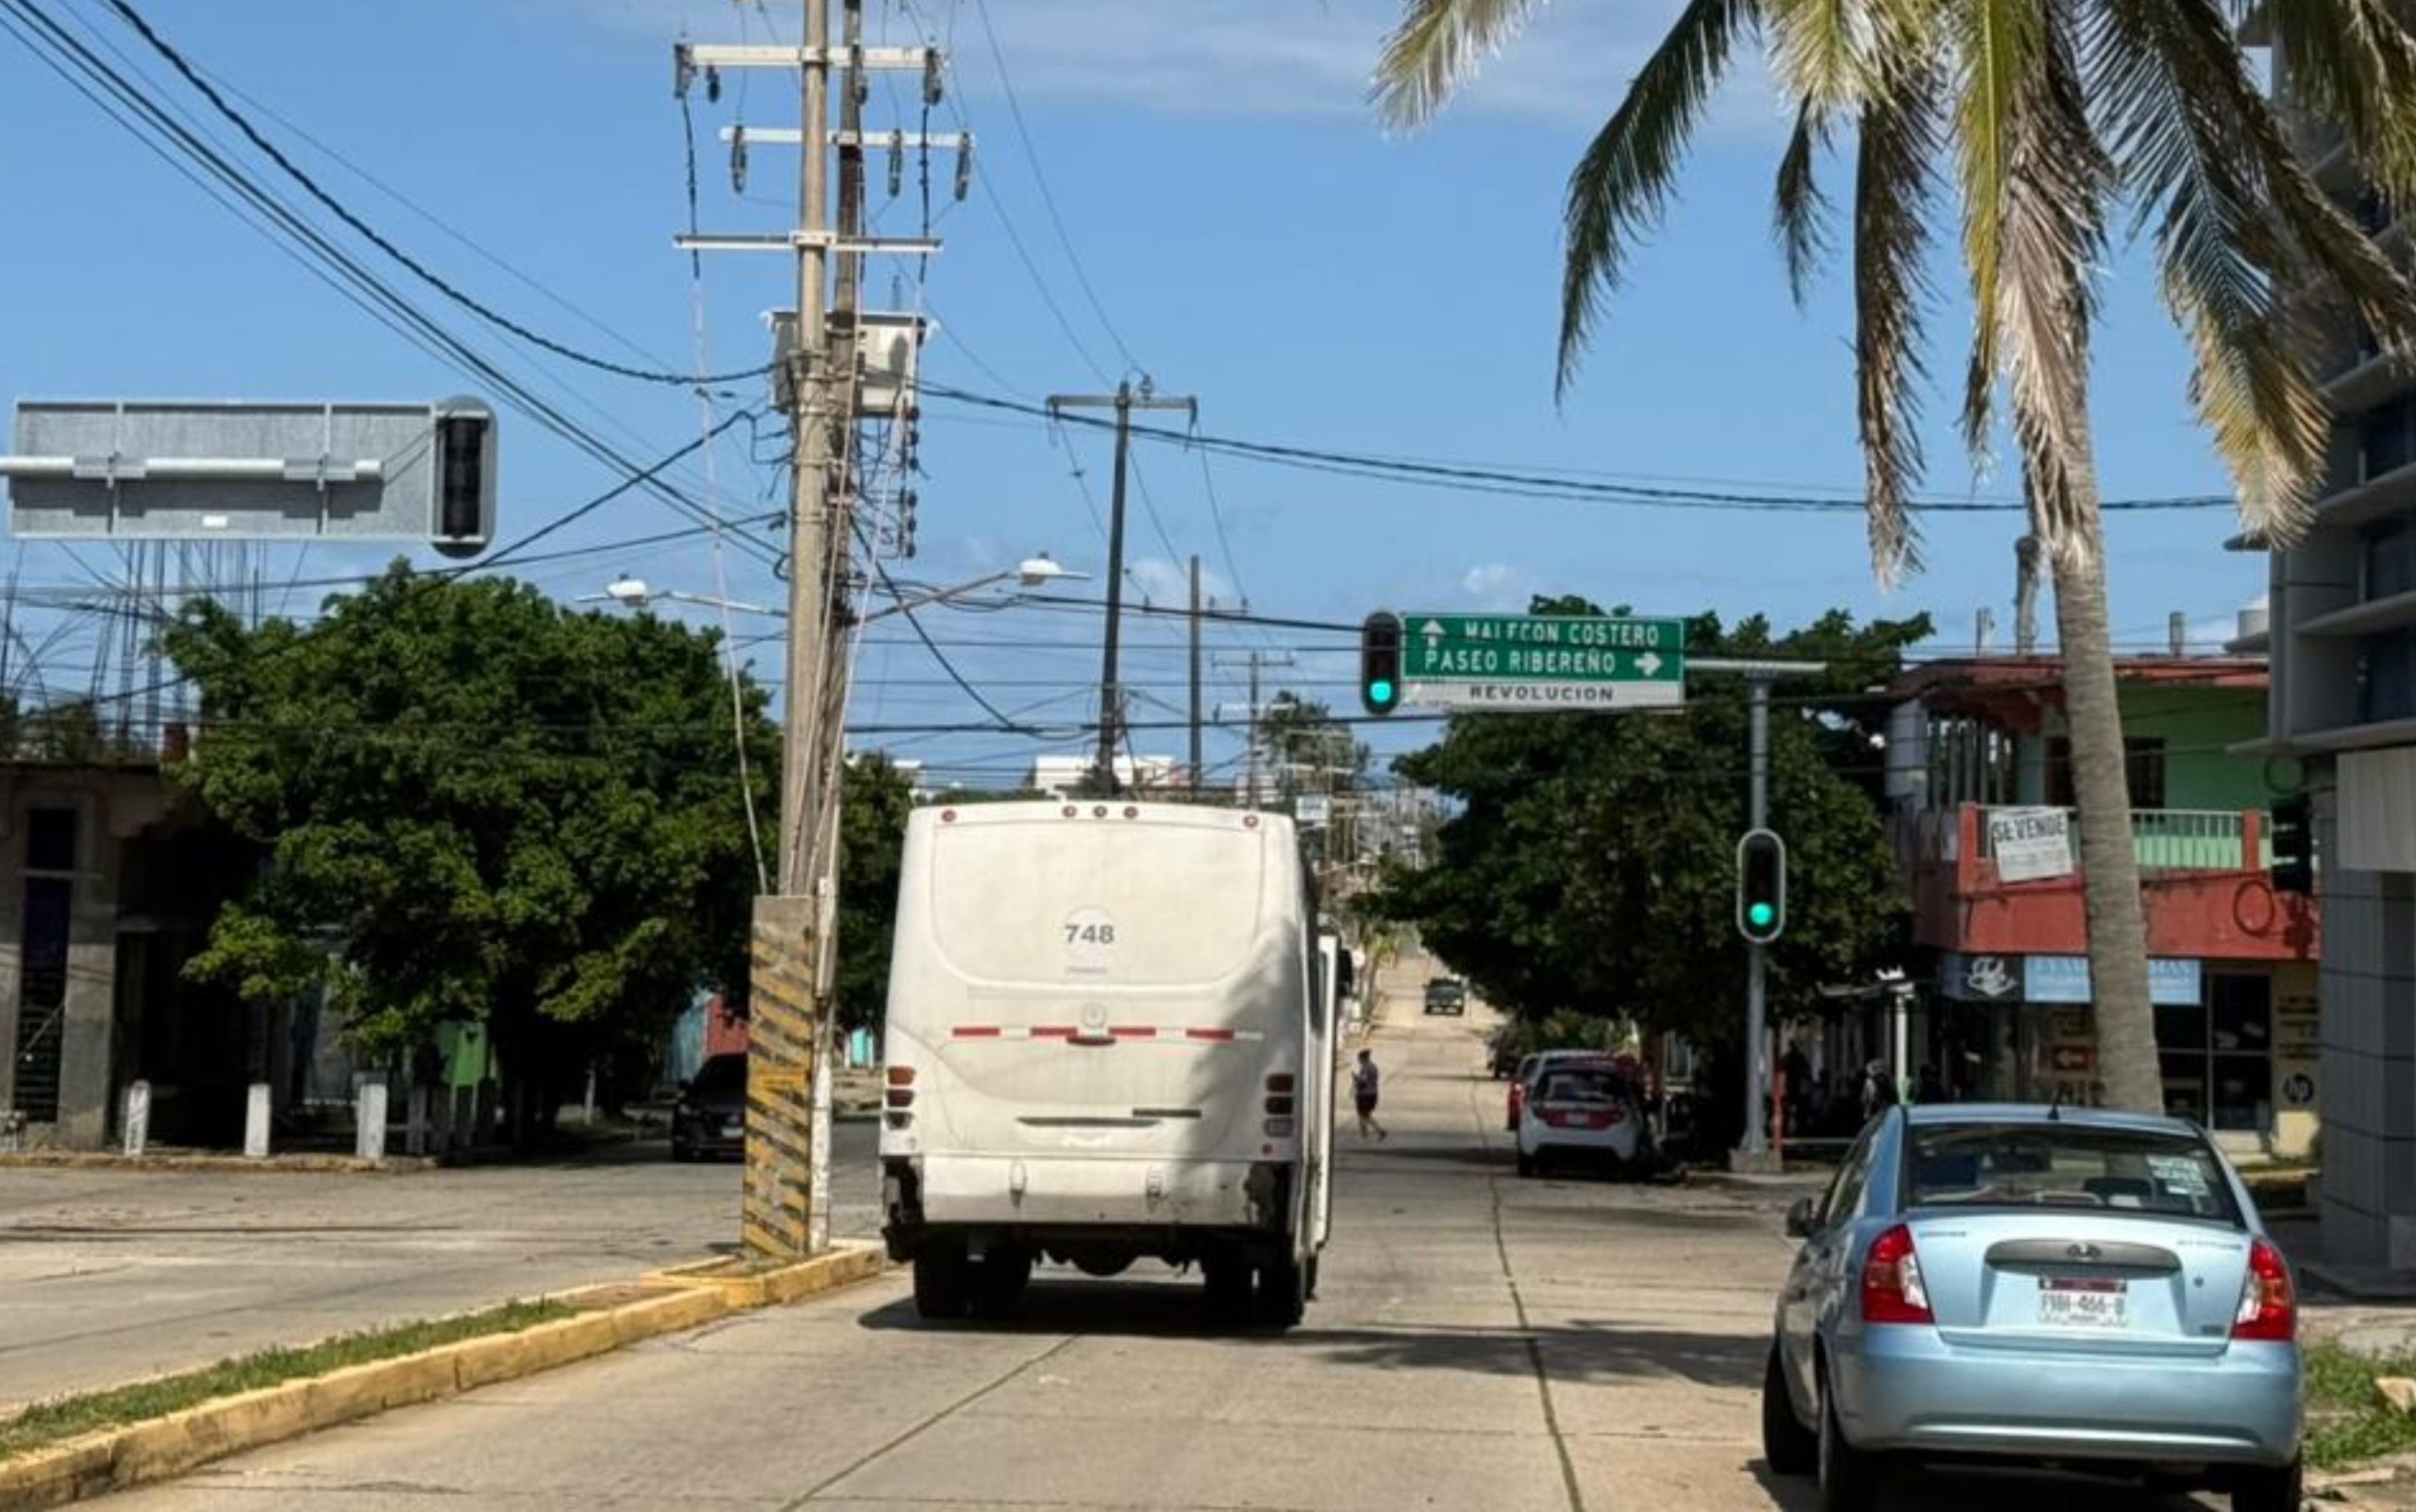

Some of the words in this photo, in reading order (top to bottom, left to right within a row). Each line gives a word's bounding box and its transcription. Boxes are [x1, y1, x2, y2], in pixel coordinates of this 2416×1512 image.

[1569, 623, 1659, 647] COSTERO
[1424, 648, 1498, 671] PASEO
[1509, 647, 1616, 674] RIBEREÑO
[1469, 684, 1614, 701] REVOLUCION
[1065, 924, 1115, 944] 748
